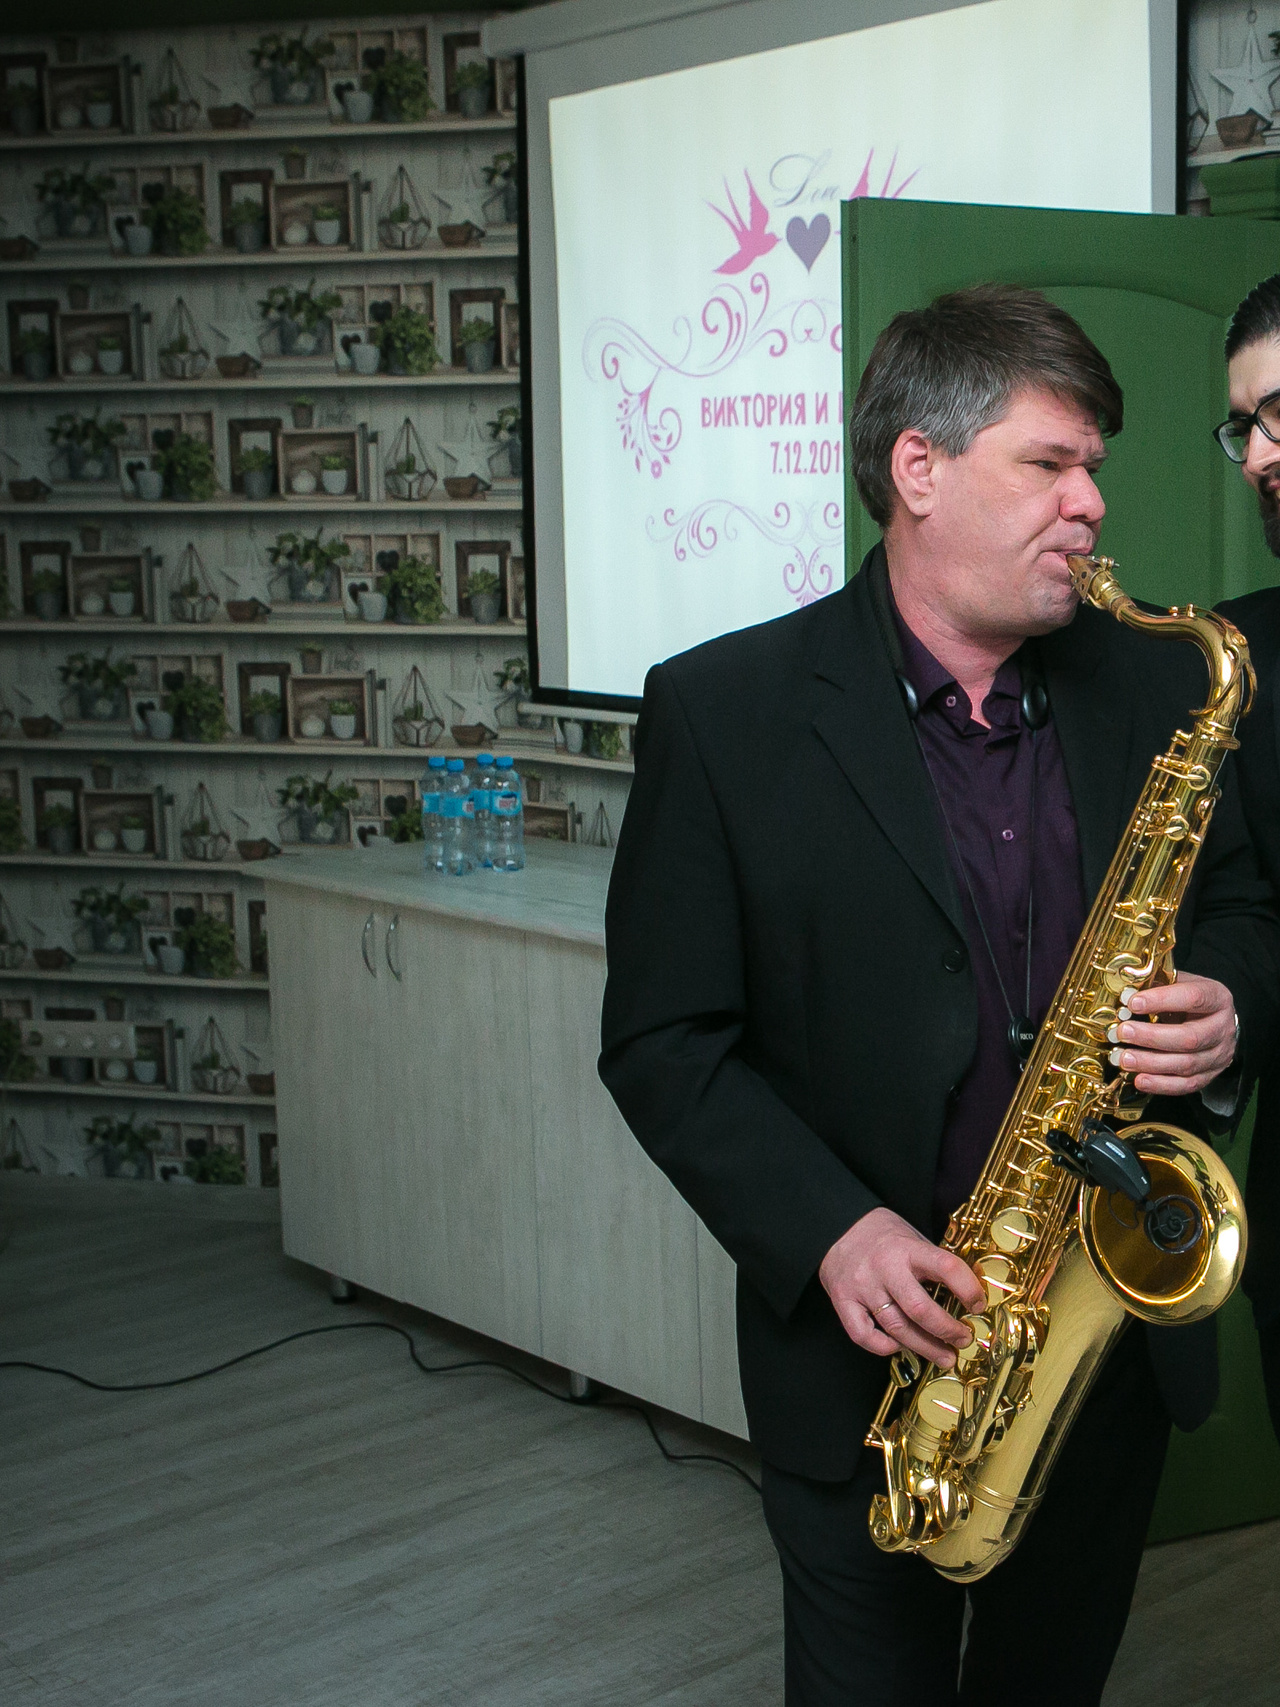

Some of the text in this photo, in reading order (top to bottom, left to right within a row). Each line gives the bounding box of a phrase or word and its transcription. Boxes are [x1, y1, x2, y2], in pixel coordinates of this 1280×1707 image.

[701, 392, 806, 428] ВИКТОРИЯ
[815, 391, 828, 425] И
[770, 439, 841, 475] 7.12.201
